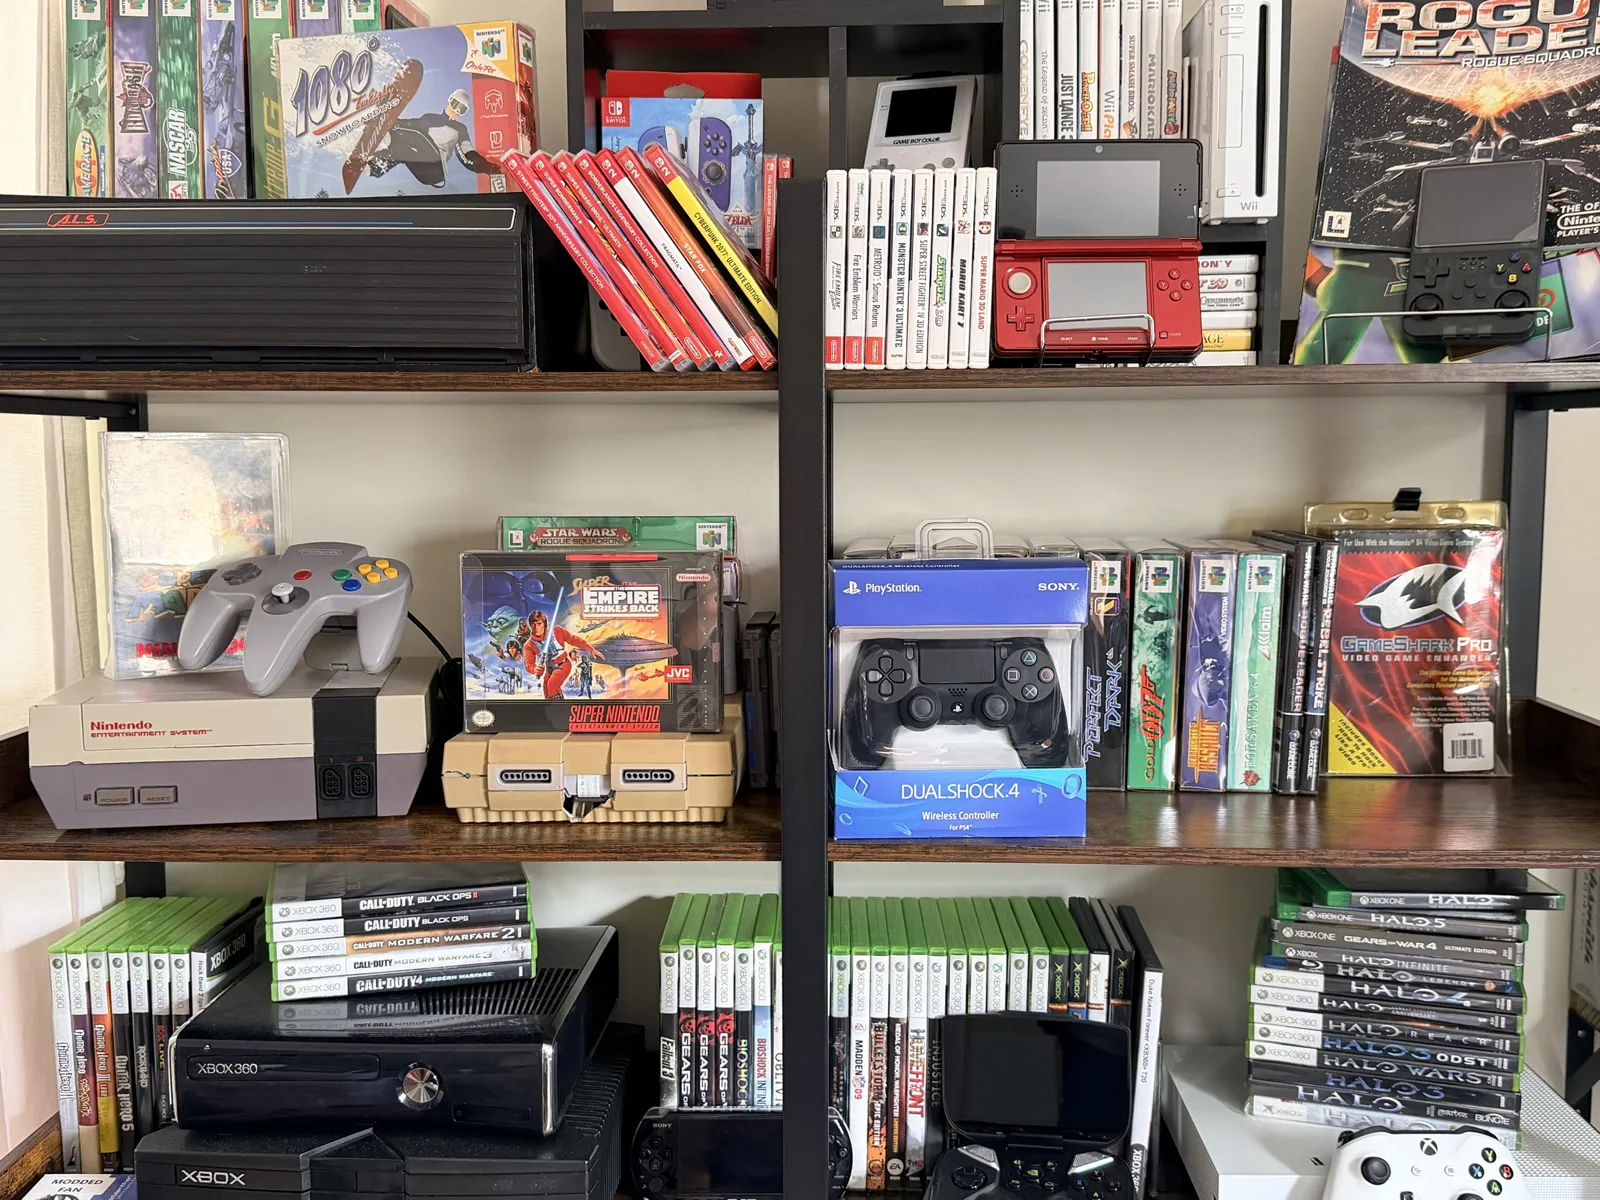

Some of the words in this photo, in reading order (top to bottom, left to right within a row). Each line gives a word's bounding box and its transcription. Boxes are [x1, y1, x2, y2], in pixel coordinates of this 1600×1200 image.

[1461, 56, 1522, 67] ROGUE
[1061, 74, 1074, 97] JUST
[314, 97, 401, 147] SNOWBOARDING
[1060, 98, 1074, 131] DANCE
[167, 107, 188, 176] NASCAR
[221, 152, 233, 175] USA
[542, 170, 557, 189] SUPER
[553, 187, 581, 221] BOMBERMAN
[1240, 201, 1259, 211] Wii
[564, 172, 579, 190] SUPER
[576, 188, 593, 208] SMASH
[601, 223, 622, 249] ULTIMATE
[585, 169, 616, 208] BORDERLANDS
[611, 205, 637, 237] LEGENDARY
[632, 235, 659, 268] COLLECTION
[513, 168, 532, 190] STREET
[553, 222, 582, 258] ANNIVERSARY
[578, 256, 605, 289] COLLECTION
[681, 242, 697, 260] STAR
[693, 258, 707, 274] FOX
[692, 211, 720, 245] CYBERPUNK
[724, 256, 747, 283] ULTIMATE
[742, 281, 763, 304] EDITION
[853, 254, 861, 266] Fire
[897, 242, 905, 275] MONSTER
[979, 256, 988, 277] SUPER
[852, 268, 861, 293] Emblem
[918, 261, 927, 281] STREET
[872, 283, 881, 302] Samus
[979, 279, 987, 300] MARIO
[852, 295, 860, 320] Warriors
[872, 304, 880, 327] Returns
[979, 302, 986, 311] 3D
[895, 314, 903, 347] ULTIMATE
[917, 320, 925, 328] 3D
[543, 528, 580, 537] STAR
[581, 528, 619, 537] WARS
[1343, 539, 1353, 547] For
[1354, 539, 1364, 547] Use
[1366, 539, 1378, 547] With
[1379, 539, 1387, 547] the
[1424, 539, 1438, 547] Video
[568, 575, 615, 596] SUPER
[583, 587, 659, 604] EMPIRE
[1038, 582, 1079, 591] SONY
[583, 604, 628, 613] STRIKES
[629, 604, 659, 613] BACK
[1316, 608, 1333, 658] REBEL
[1342, 654, 1379, 662] VIDEO
[1385, 654, 1420, 662] GAME
[1426, 654, 1492, 662] ENHANCER
[666, 668, 690, 678] JVC
[1312, 658, 1329, 709] STRIKE
[569, 705, 606, 723] SUPER
[605, 705, 660, 723] NINTENDO
[90, 720, 153, 731] Nintendo
[1244, 694, 1260, 769] FORSAKEN
[1199, 720, 1221, 773] ASSAULT
[1286, 742, 1295, 780] GAMECUBE
[1306, 739, 1316, 780] GAMECUBE
[922, 811, 957, 821] Wireless
[958, 811, 999, 821] Controller
[1428, 894, 1494, 905] HALO
[1371, 913, 1433, 927] HALO
[1434, 918, 1446, 928] 5
[388, 936, 440, 947] MODERN
[443, 932, 499, 942] WARFARE
[501, 927, 515, 938] 2
[1344, 935, 1387, 946] GEARS
[1396, 940, 1426, 950] WAR
[1444, 945, 1472, 953] ULTIMATE
[1473, 947, 1498, 955] EDITION
[394, 956, 435, 965] MODERN
[437, 953, 481, 961] WARFARE
[482, 951, 493, 959] 3
[1296, 949, 1318, 959] XBOX
[1342, 953, 1396, 967] HALO
[1396, 960, 1449, 973] INFINITE
[1336, 964, 1416, 982] HALO
[1350, 982, 1439, 1002] HALO
[1323, 998, 1385, 1012] HALO
[1391, 1010, 1436, 1019] ANNIVERSARY
[75, 1029, 85, 1054] GUITAR
[1323, 1036, 1406, 1057] HALO
[1411, 1048, 1431, 1060] 3
[1436, 1053, 1488, 1066] ODST
[56, 1043, 70, 1069] GUITAR
[77, 1055, 87, 1074] HERO
[663, 1040, 674, 1069] Fallout
[700, 1035, 708, 1090] GEARS
[720, 1033, 728, 1090] GEARS
[854, 1040, 863, 1075] MADDEN
[116, 1055, 129, 1091] GUITAR
[908, 1029, 925, 1118] HOMEFRONT
[930, 1039, 942, 1107] INJUSTICE
[1323, 1054, 1400, 1073] HALO
[1405, 1065, 1482, 1084] WARS
[59, 1070, 72, 1091] HERO
[1326, 1073, 1421, 1096] HALO
[1423, 1086, 1446, 1099] 3
[854, 1088, 863, 1100] 09
[1297, 1085, 1405, 1111] HALO
[118, 1094, 133, 1122] HERO
[1438, 1109, 1468, 1118] gearbox
[1475, 1113, 1510, 1125] BUNGIE
[873, 1120, 881, 1147] EDITION
[181, 1169, 246, 1186] XBOX
